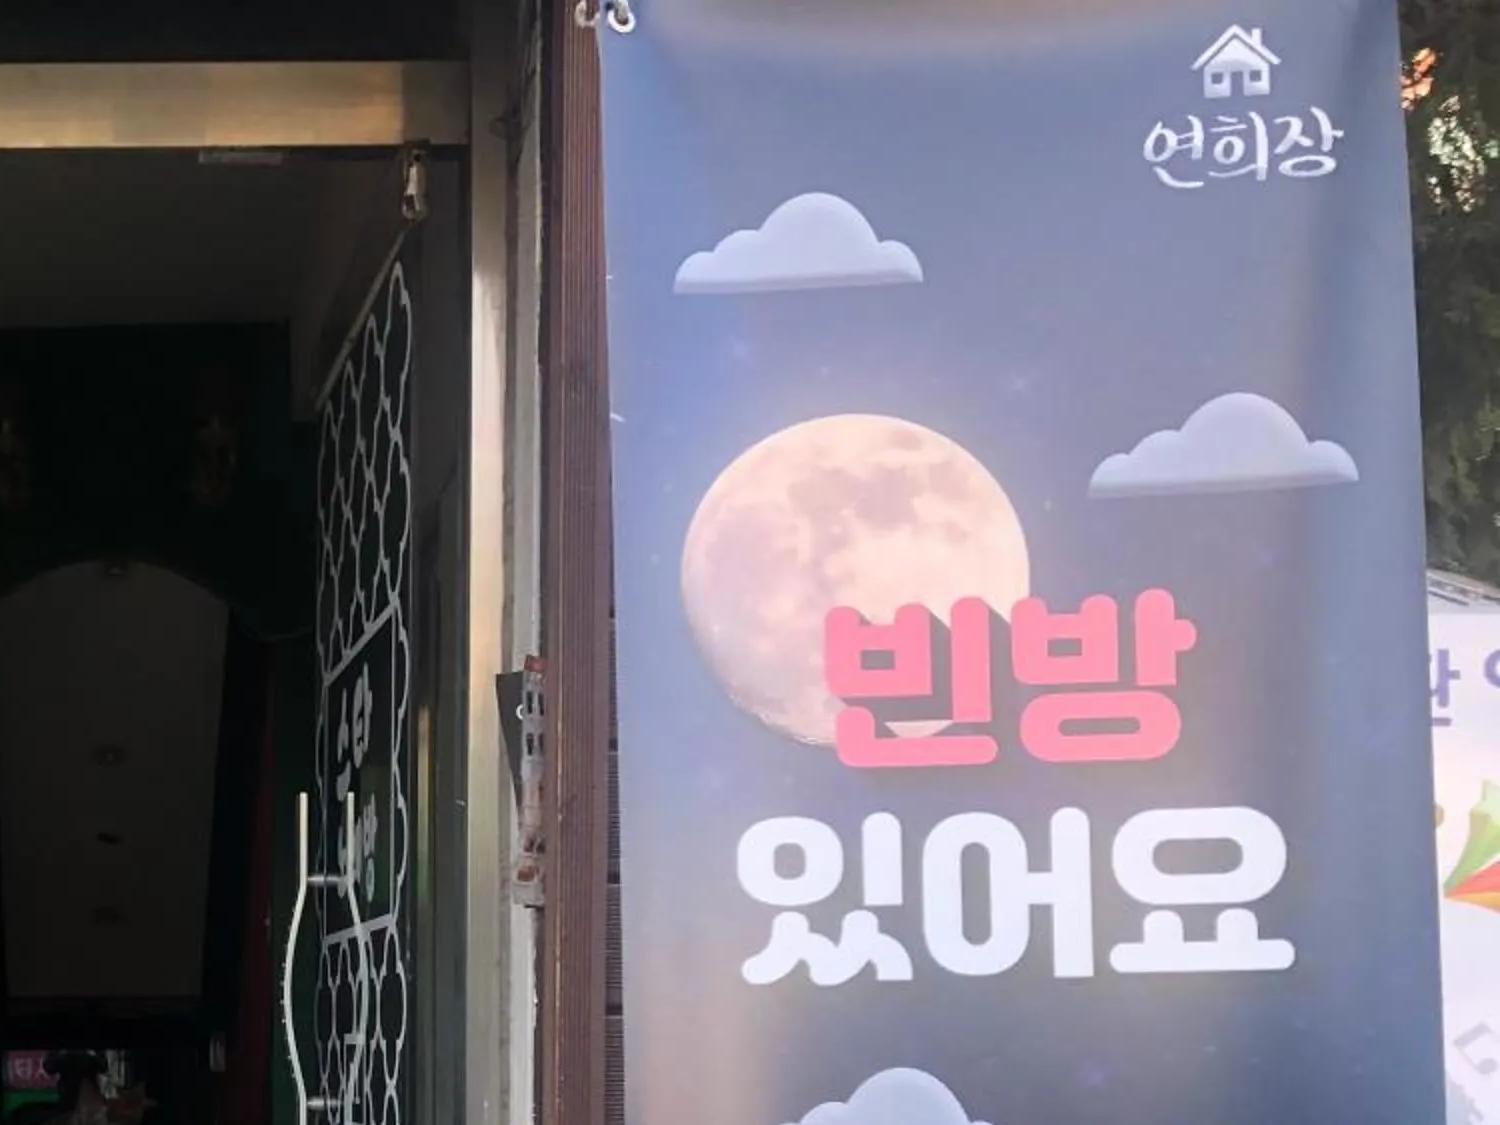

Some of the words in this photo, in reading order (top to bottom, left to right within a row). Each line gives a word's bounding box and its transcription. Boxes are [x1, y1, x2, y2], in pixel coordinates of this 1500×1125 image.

[1142, 105, 1345, 189] 연희장
[823, 588, 1198, 768] 빈방
[736, 806, 1296, 987] 있어요
